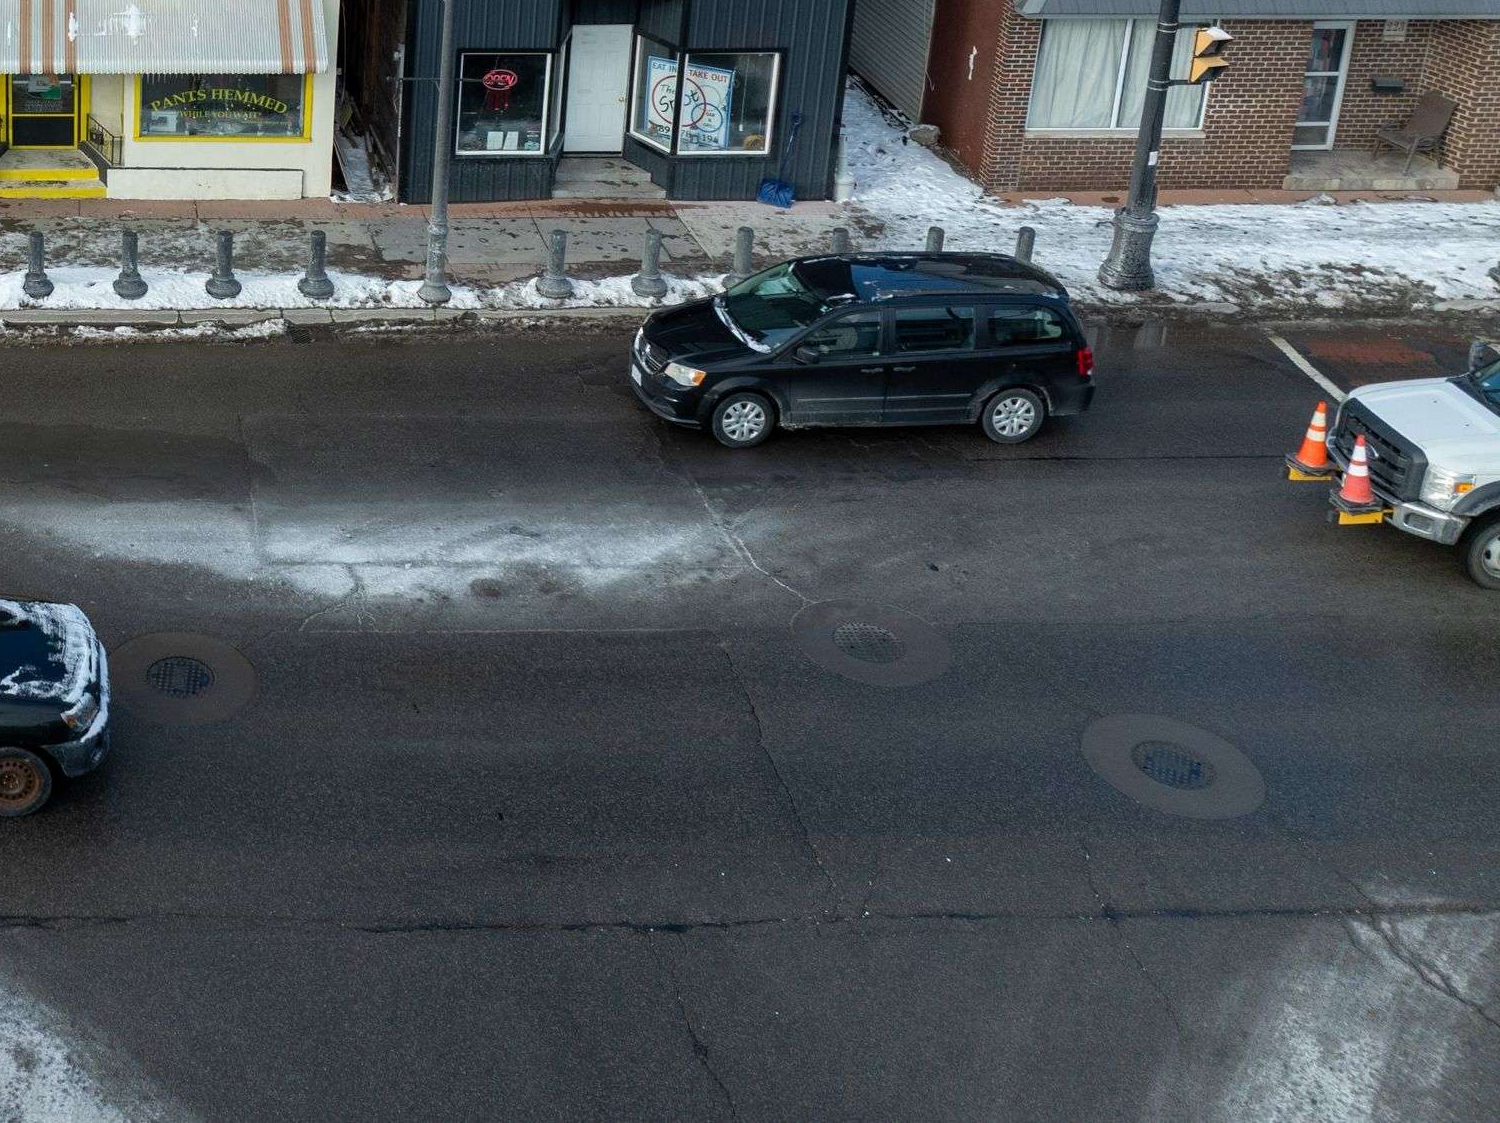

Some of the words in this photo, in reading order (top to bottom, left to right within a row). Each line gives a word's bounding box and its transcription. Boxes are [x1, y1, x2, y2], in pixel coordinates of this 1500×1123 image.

[689, 69, 709, 80] TAKE
[711, 74, 728, 83] OUT
[151, 89, 207, 112] PANTS
[211, 88, 288, 114] HEMMED
[180, 110, 209, 118] WHILE
